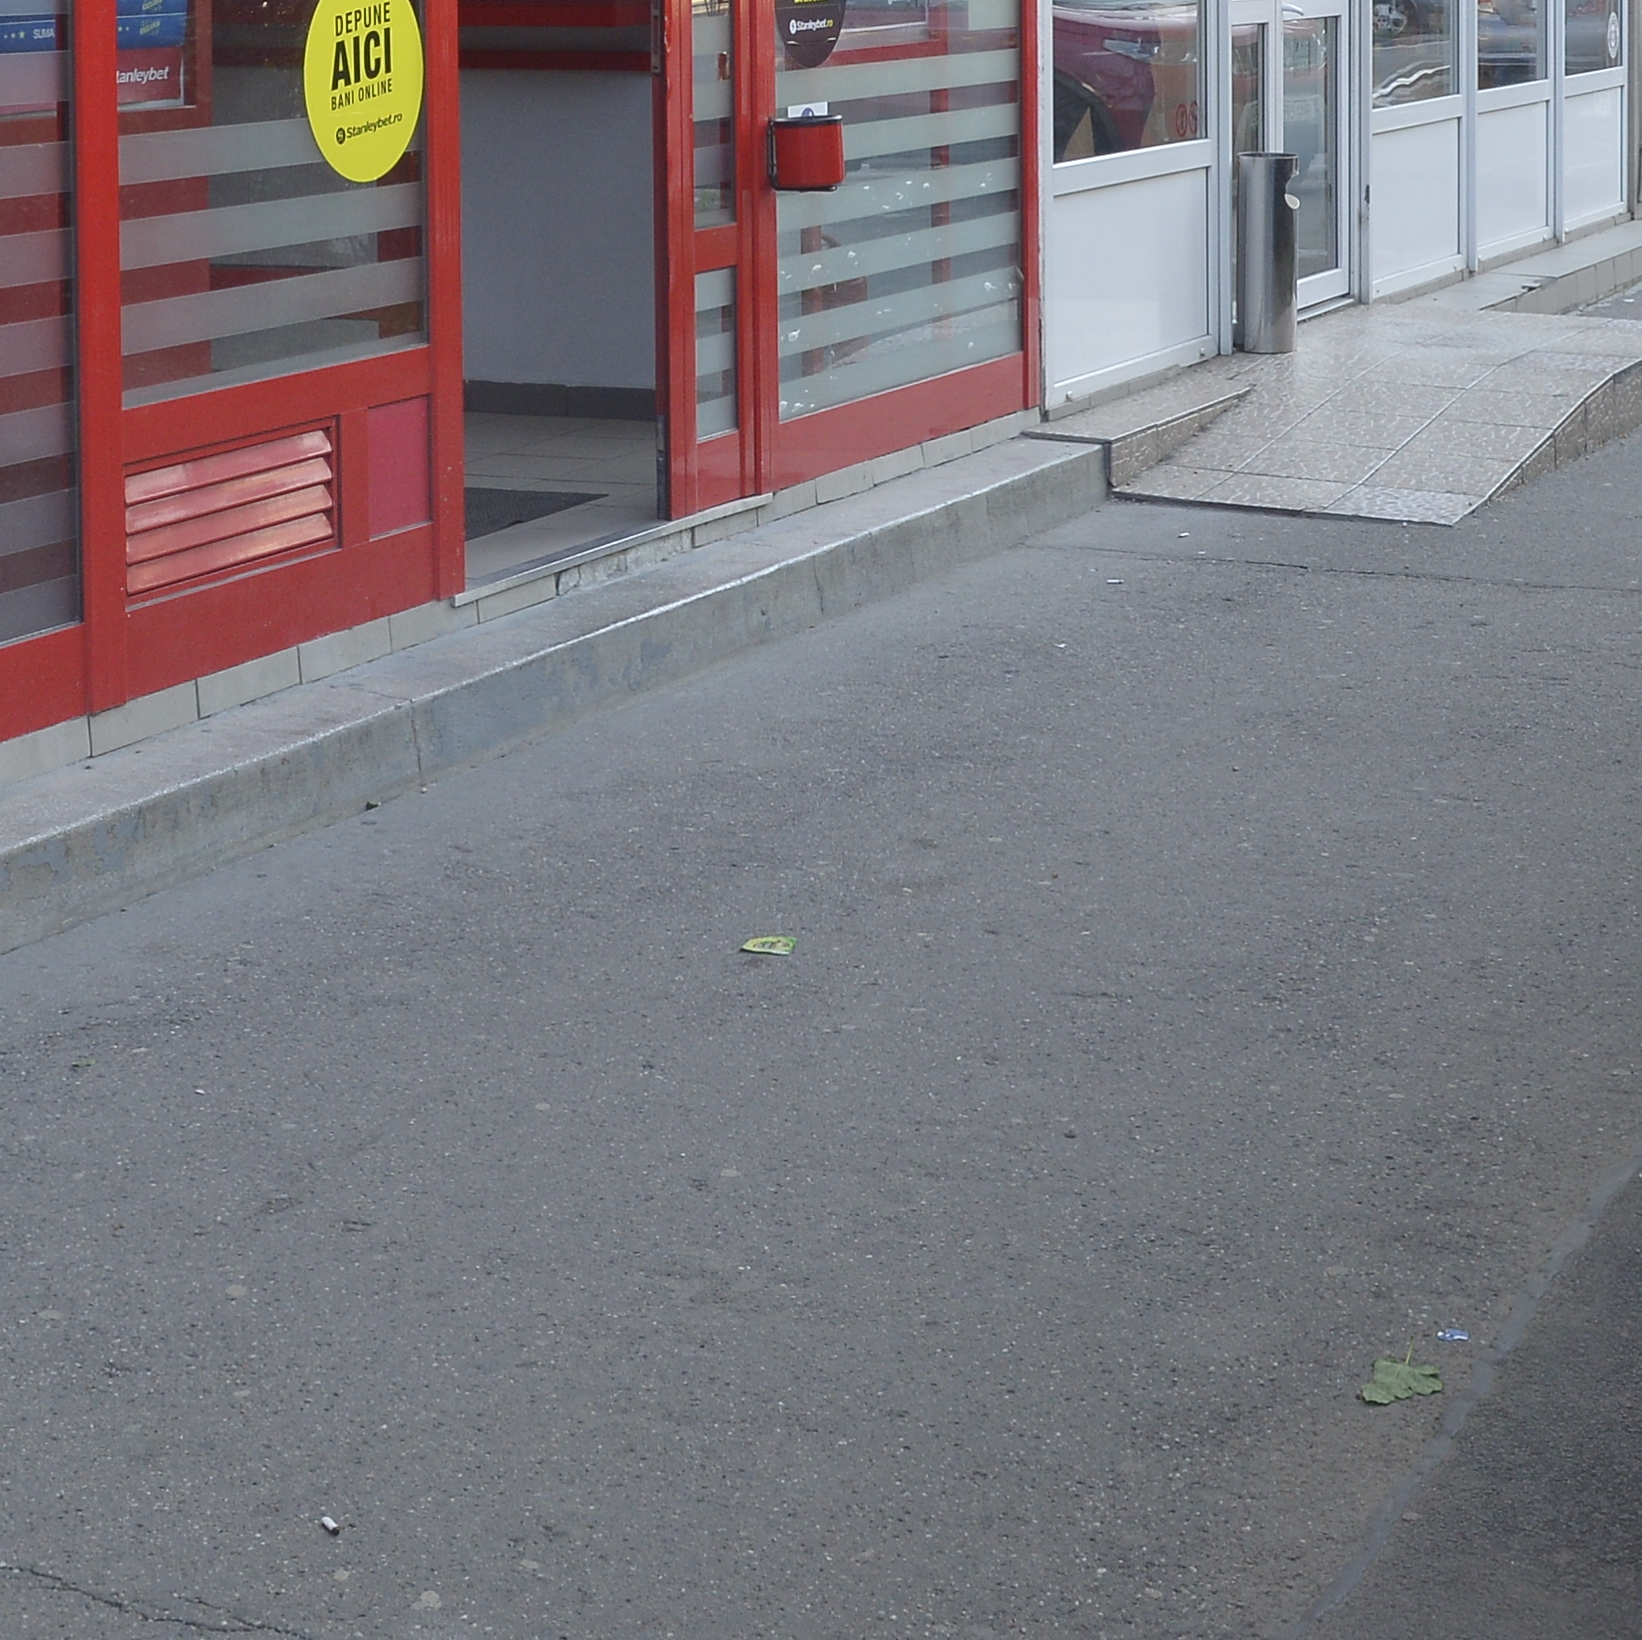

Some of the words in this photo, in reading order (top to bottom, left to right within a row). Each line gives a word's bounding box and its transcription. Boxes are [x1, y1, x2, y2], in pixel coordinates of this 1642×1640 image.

[334, 1, 391, 37] DEPUNE
[330, 26, 393, 91] AICI
[330, 89, 355, 111] BANI
[358, 78, 393, 103] ONLINE
[346, 112, 403, 140] Stanleybet.ro
